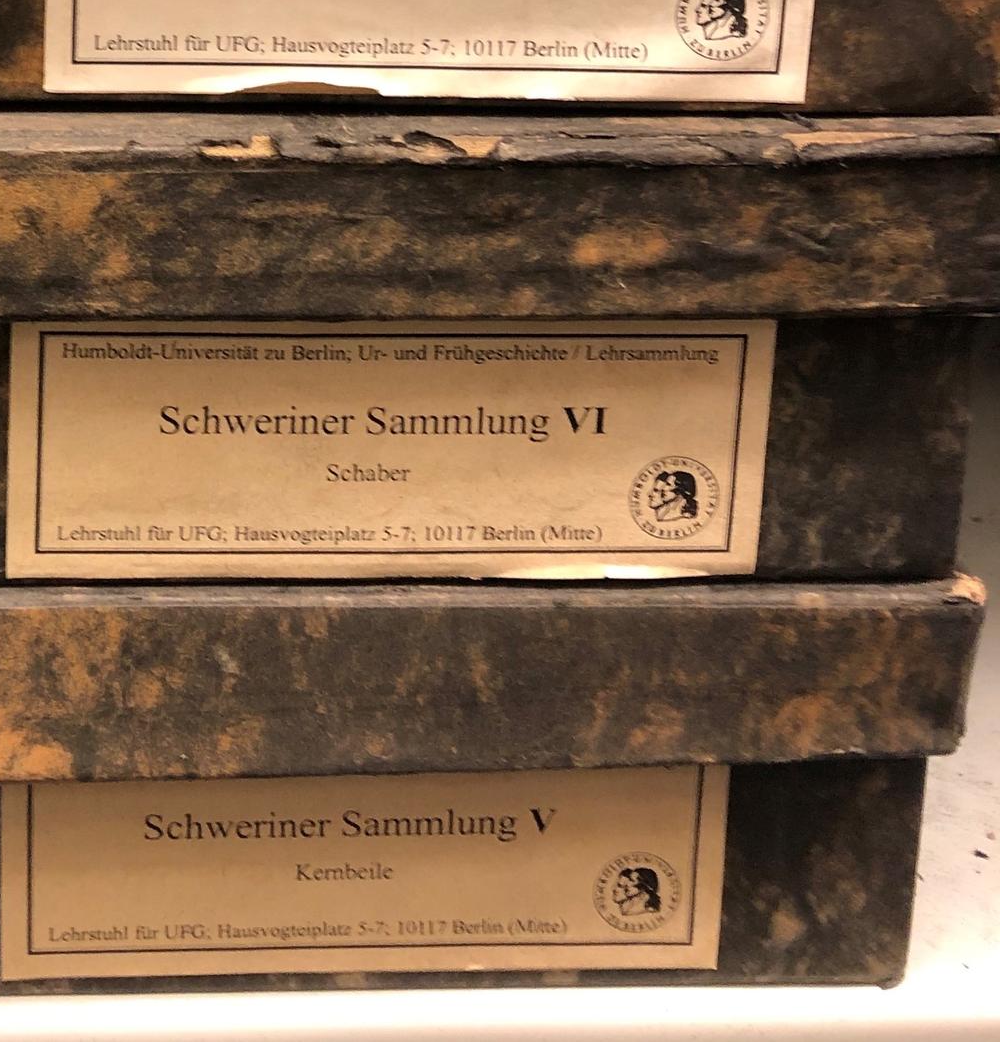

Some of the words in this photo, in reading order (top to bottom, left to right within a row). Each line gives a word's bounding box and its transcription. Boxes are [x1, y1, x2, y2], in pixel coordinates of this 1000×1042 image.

[94, 34, 178, 52] Lehrstuhl
[184, 34, 212, 52] für
[215, 35, 265, 54] UFG;
[272, 36, 415, 59] Hausvogteiplatz
[420, 38, 456, 56] 5-7;
[464, 39, 517, 57] 10117
[523, 40, 578, 58] Berlin
[583, 41, 649, 61] (Mitte)
[62, 341, 259, 361] Humboldt-Universität
[263, 348, 286, 361] zu
[291, 344, 352, 364] Berlin;
[357, 344, 389, 362] Ur-
[393, 344, 429, 362] und
[433, 343, 569, 365] Frühgeschichte
[570, 343, 582, 361] /
[585, 344, 720, 366] Lehrsammlung
[159, 405, 356, 436] Schweriner
[365, 406, 550, 443] Sammlung
[561, 406, 609, 436] VI
[326, 463, 411, 483] Schaber
[57, 525, 142, 542] Lehrstuhl
[147, 525, 174, 542] für
[178, 525, 228, 544] UFG;
[234, 525, 376, 546] Hausvogteiplatz
[381, 525, 417, 543] 5-7;
[424, 525, 478, 542] 10117
[481, 524, 536, 542] Berlin
[539, 524, 603, 544] (Mitte)
[144, 811, 332, 841] Schweriner
[341, 808, 518, 843] Sammlung
[527, 807, 558, 835] V
[295, 861, 394, 882] Kernbeile
[48, 925, 129, 943] Lehrstuhl
[135, 925, 160, 941] für
[216, 920, 354, 942] Hausvogteiplatz
[397, 919, 449, 936] 10117
[451, 918, 505, 935] Berlin
[506, 917, 568, 937] (Mitte)
